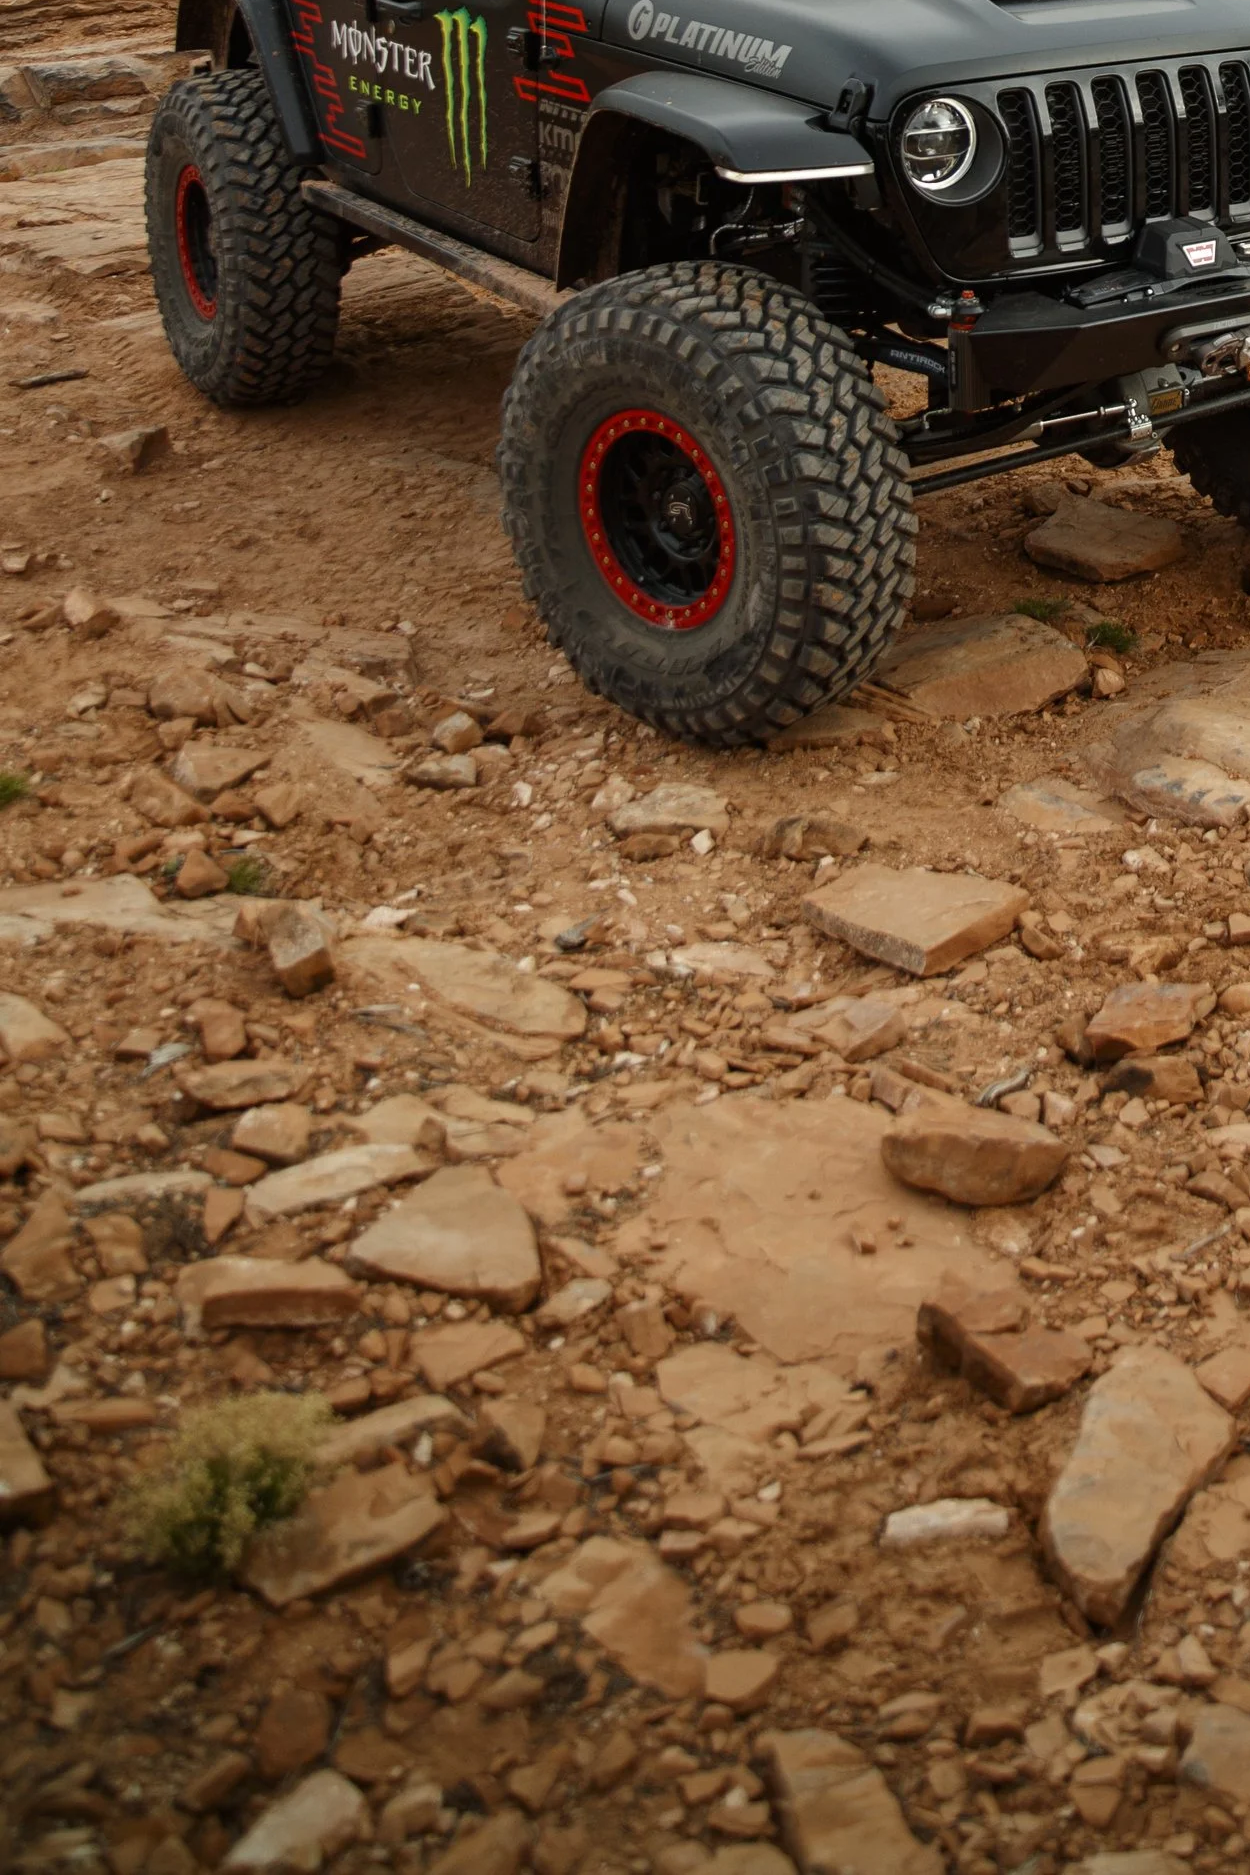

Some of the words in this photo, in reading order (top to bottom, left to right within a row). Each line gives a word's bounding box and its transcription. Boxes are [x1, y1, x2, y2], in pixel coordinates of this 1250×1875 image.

[330, 19, 436, 91] MONSTER
[649, 11, 793, 69] PLATINUM
[744, 57, 782, 80] Edition
[348, 75, 422, 115] ENERGY
[890, 349, 946, 374] ANTIROCK
